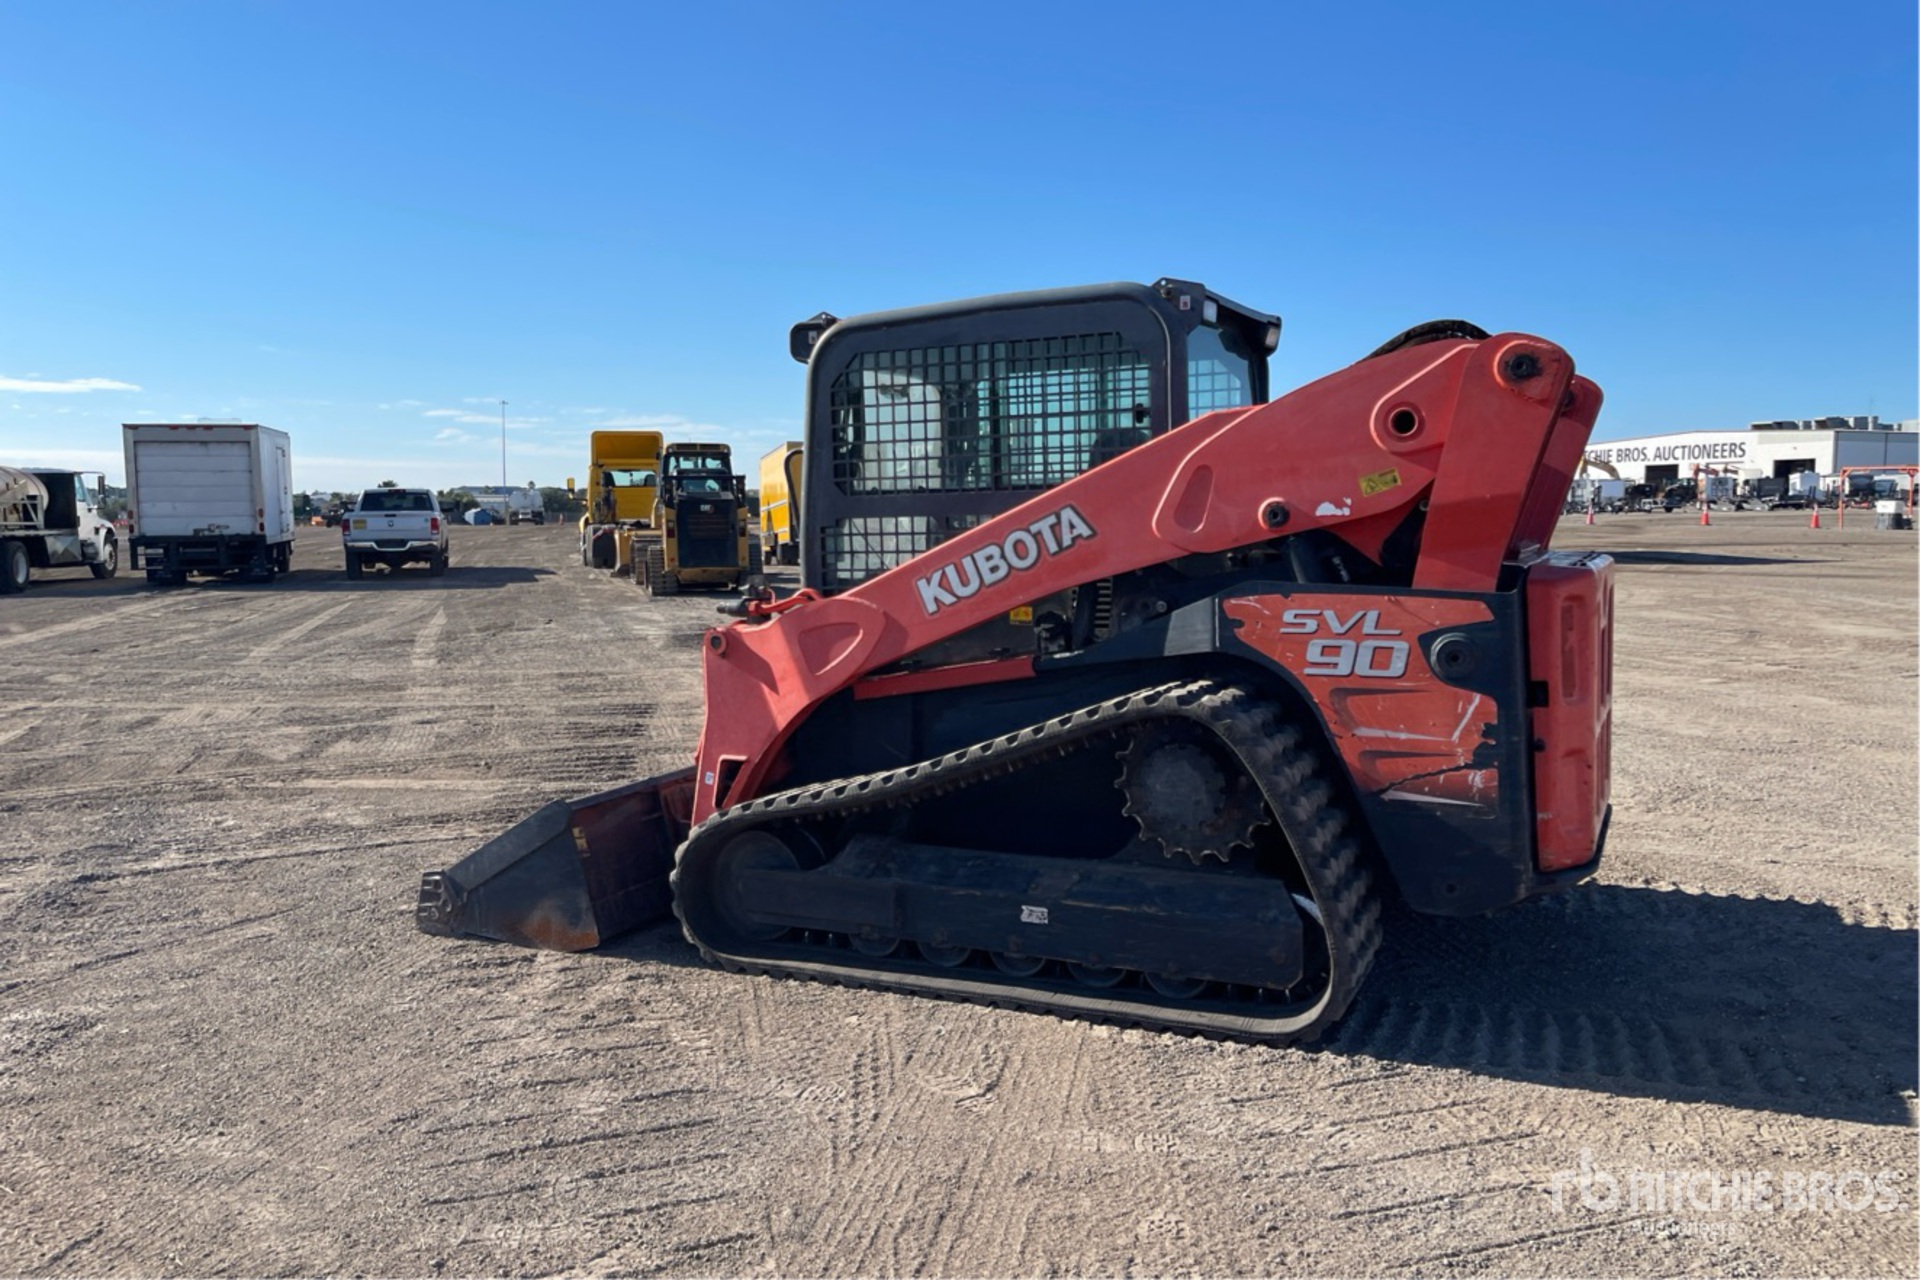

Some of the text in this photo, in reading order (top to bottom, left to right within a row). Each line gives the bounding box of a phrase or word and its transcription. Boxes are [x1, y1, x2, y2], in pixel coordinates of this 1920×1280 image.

[1616, 446, 1650, 463] BROS.
[1652, 442, 1746, 461] AUCTIONEERS
[916, 505, 1096, 614] KUBOTA
[1280, 609, 1402, 635] SVL
[1303, 638, 1410, 677] 90
